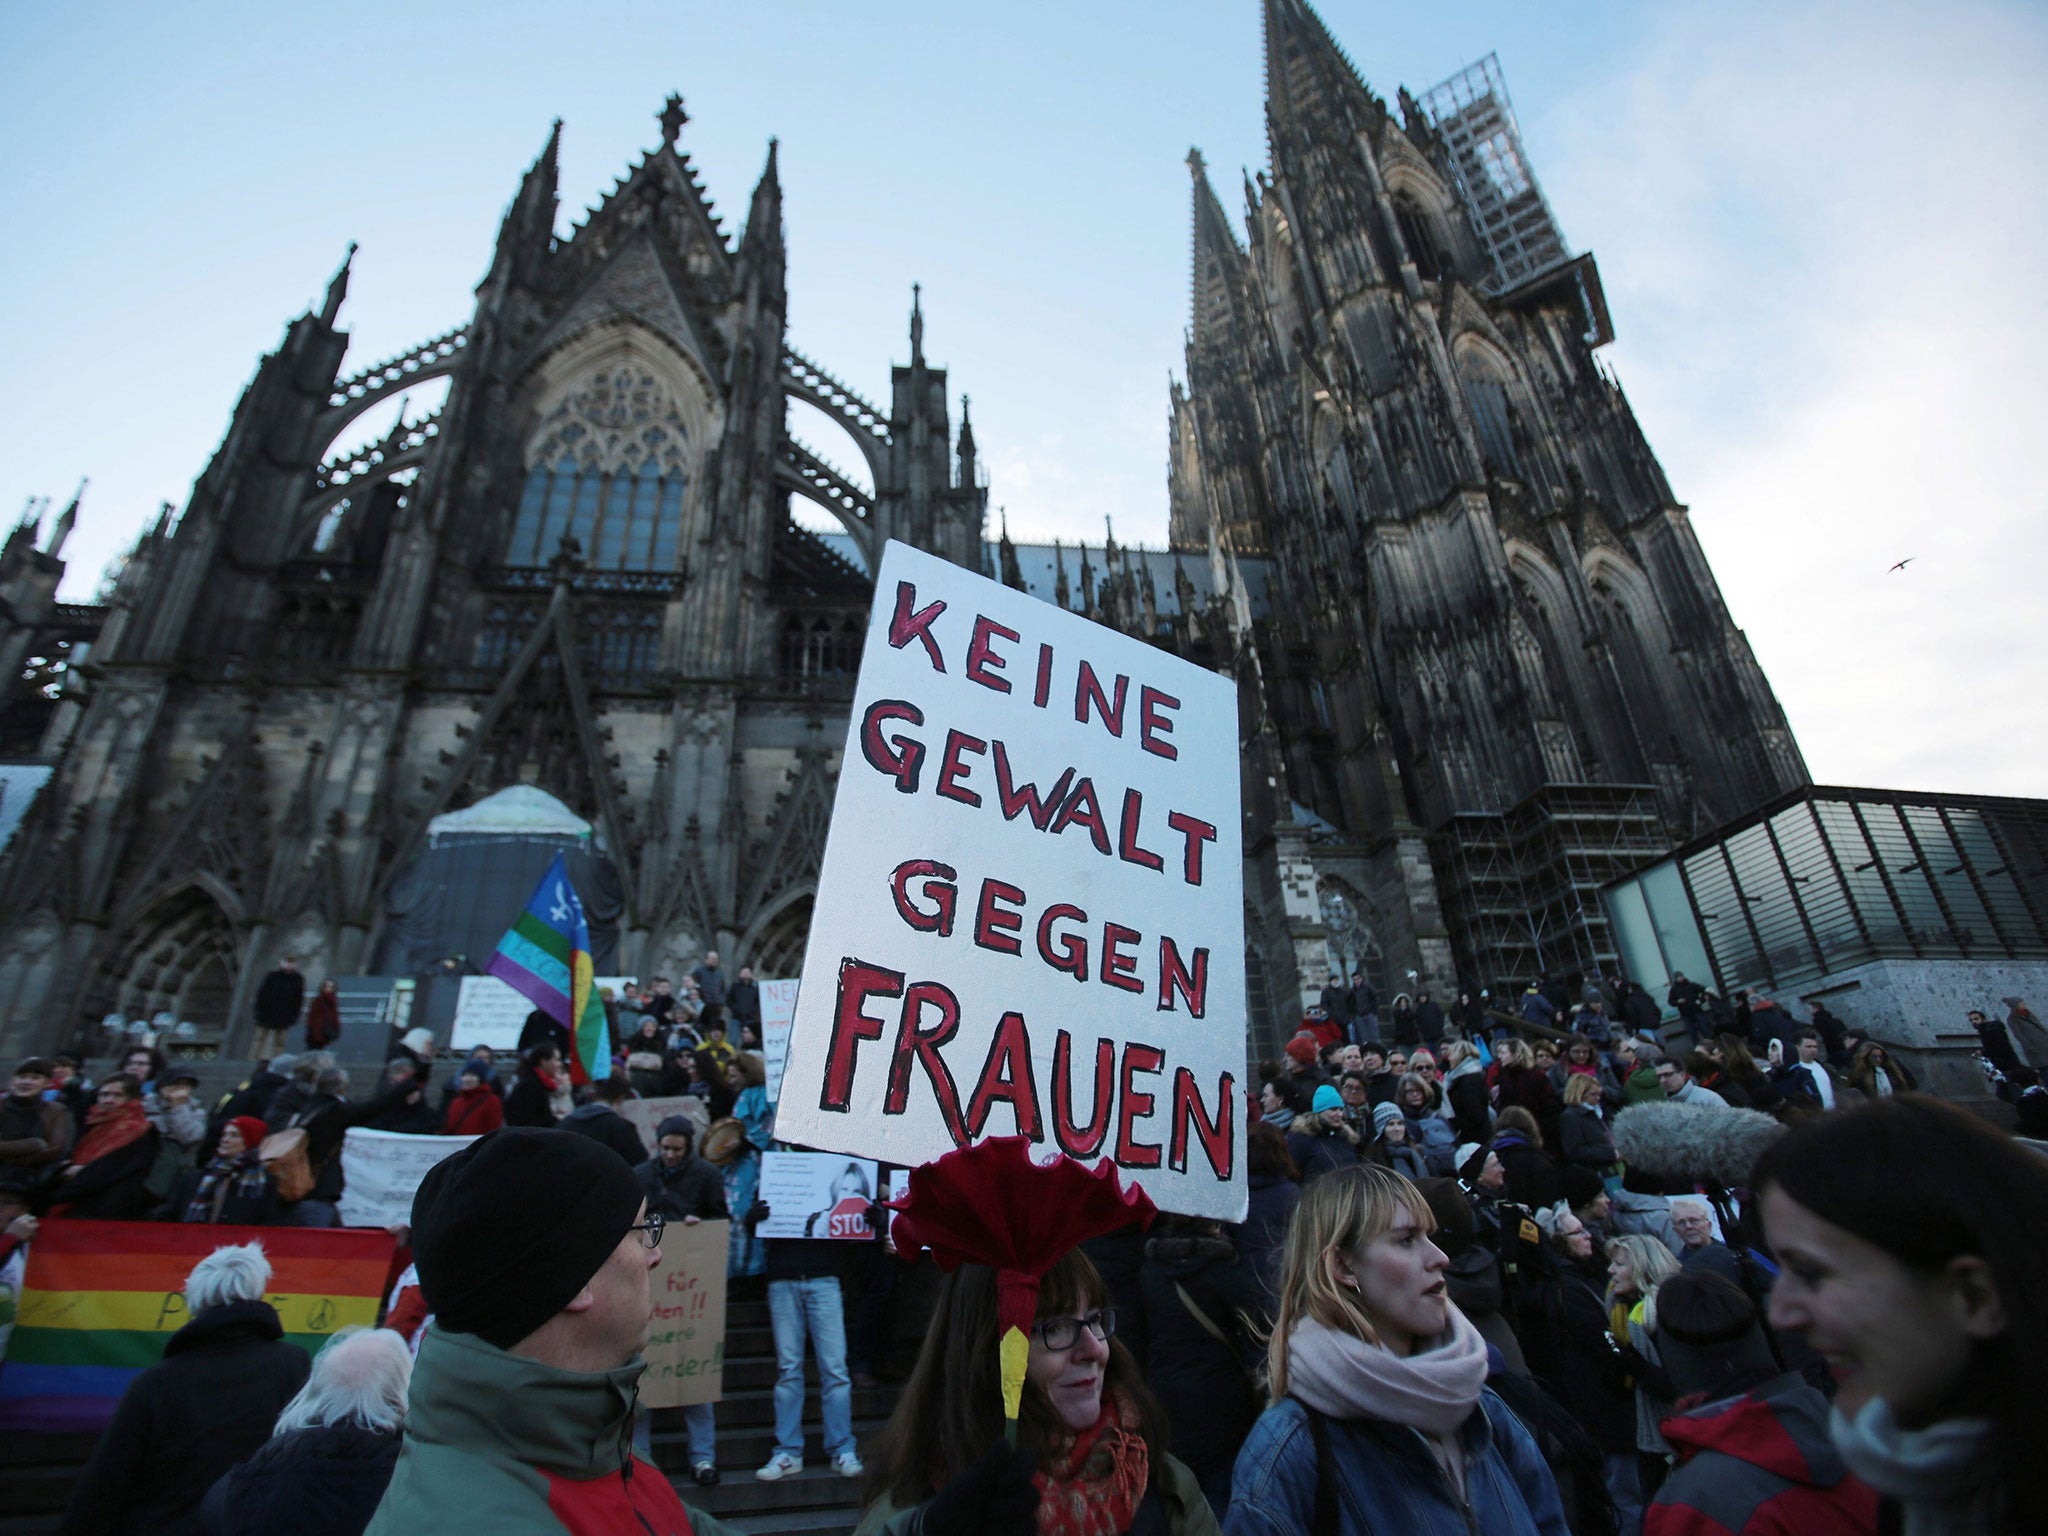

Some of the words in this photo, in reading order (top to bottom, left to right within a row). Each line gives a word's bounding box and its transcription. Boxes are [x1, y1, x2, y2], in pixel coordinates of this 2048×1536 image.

[888, 580, 1180, 761] KEINE
[860, 699, 1217, 886] GEWALT
[890, 859, 1210, 1019] GEGEN
[819, 956, 1235, 1182] FRAUEN
